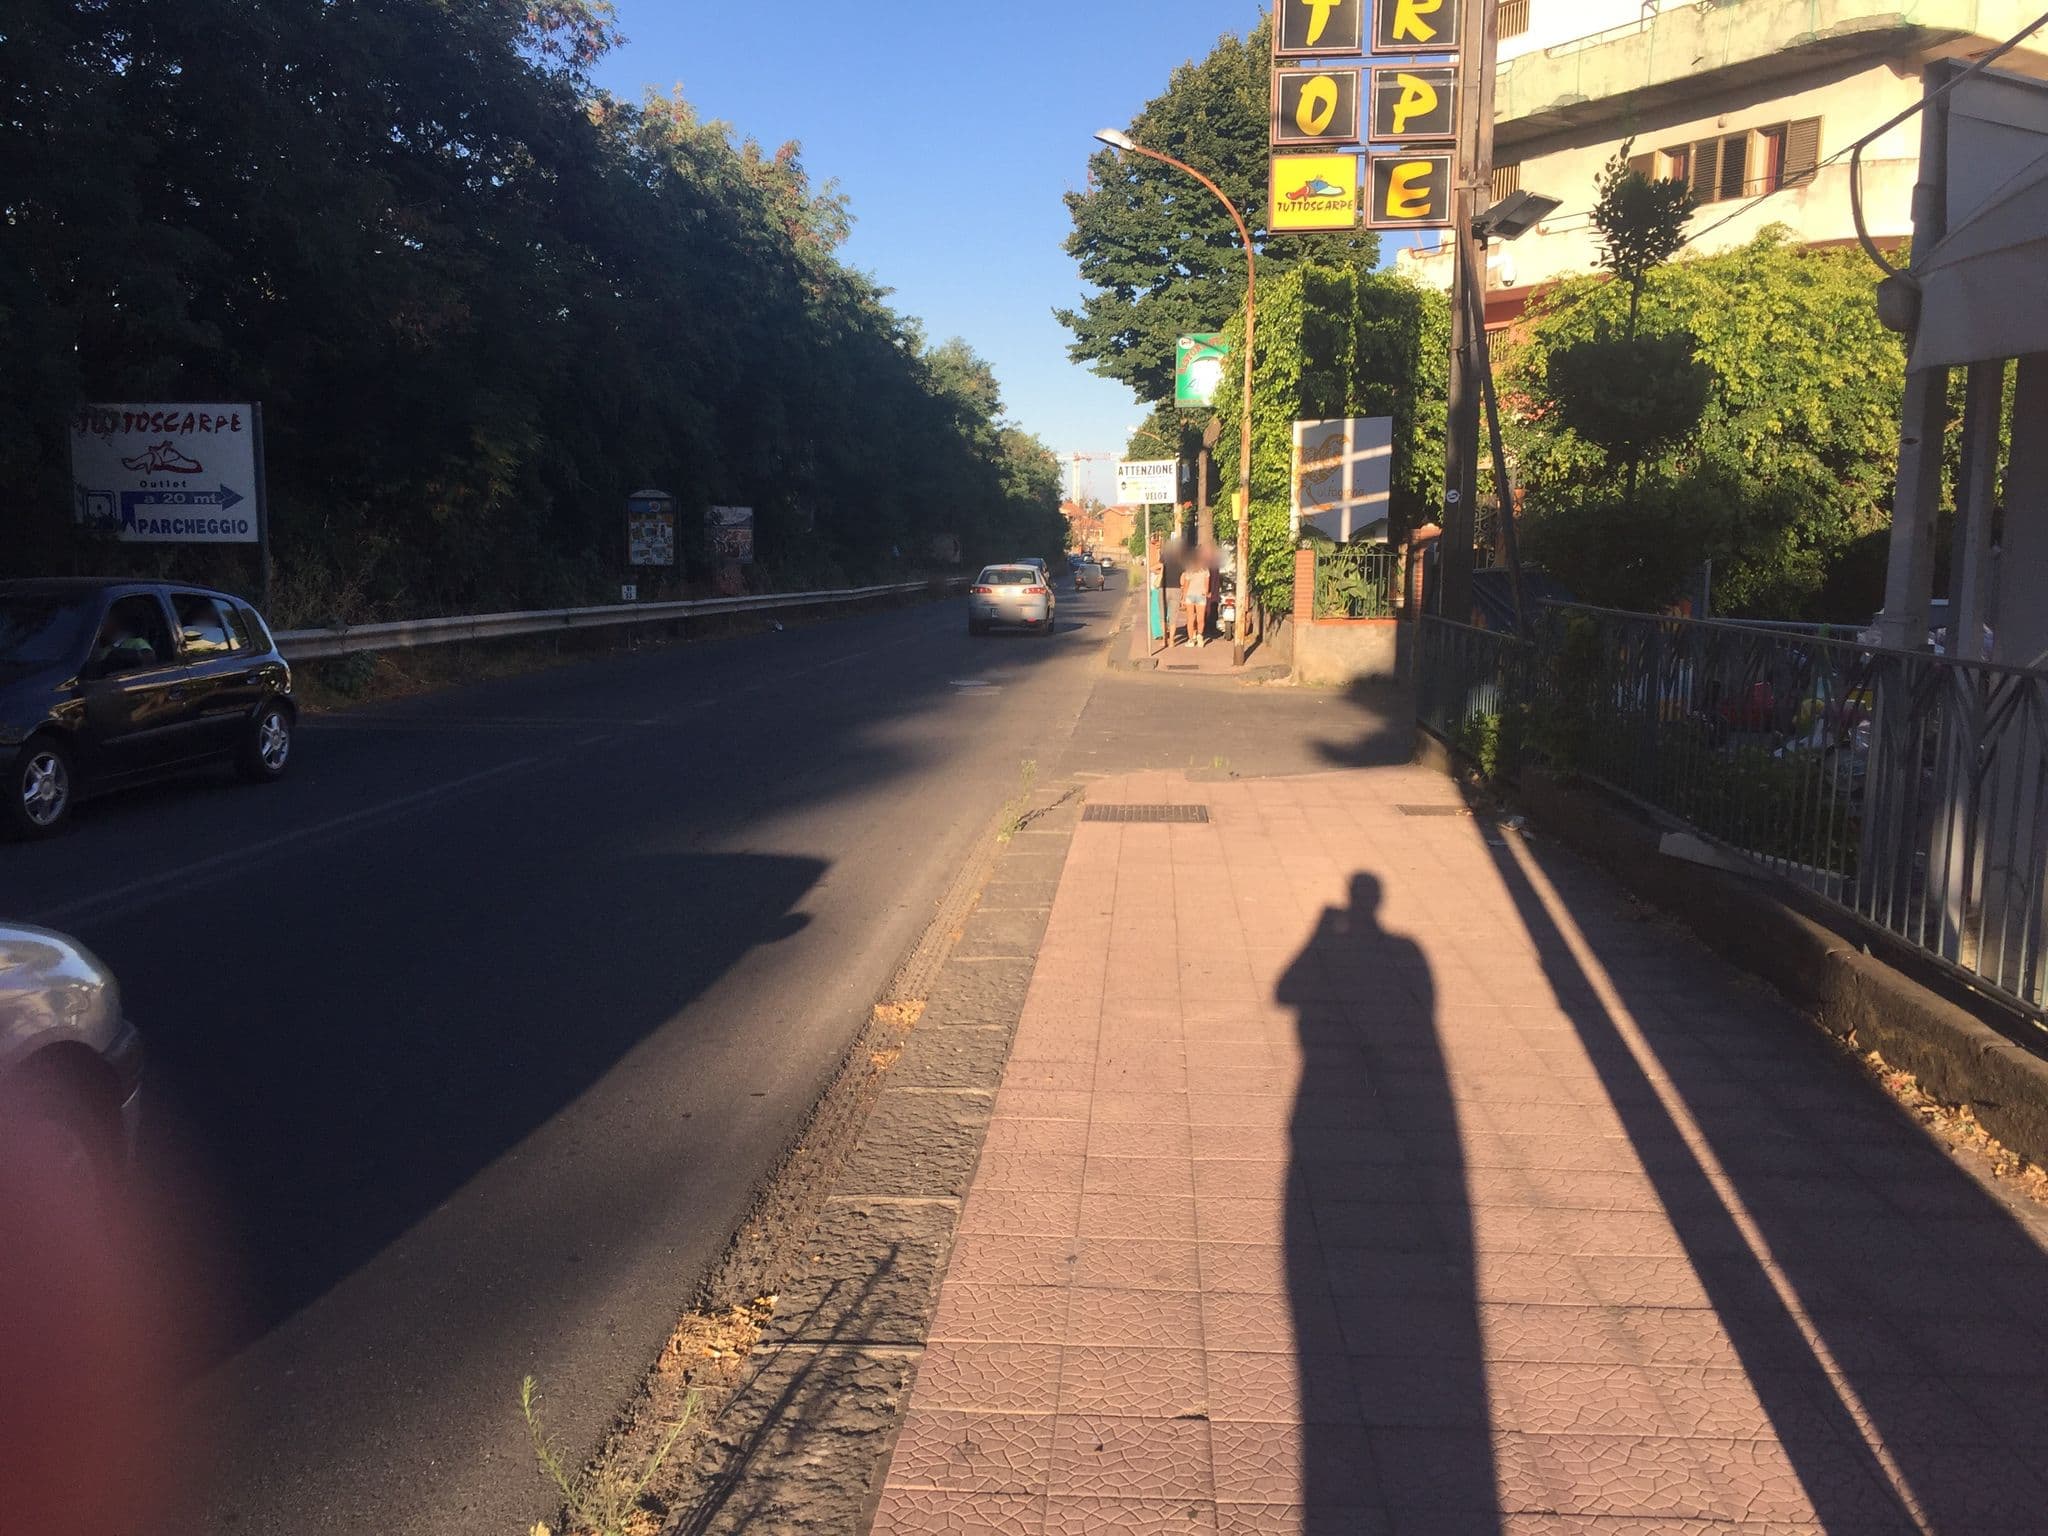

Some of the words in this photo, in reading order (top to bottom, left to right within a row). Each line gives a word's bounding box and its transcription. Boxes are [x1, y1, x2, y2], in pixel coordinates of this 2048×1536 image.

[1277, 200, 1353, 213] TUTTOSCARPE
[1118, 464, 1173, 476] ATTENZIONE
[139, 480, 187, 489] Outlet
[143, 495, 155, 504] a
[162, 492, 186, 504] 20
[138, 518, 249, 535] PARCHEGGIO
